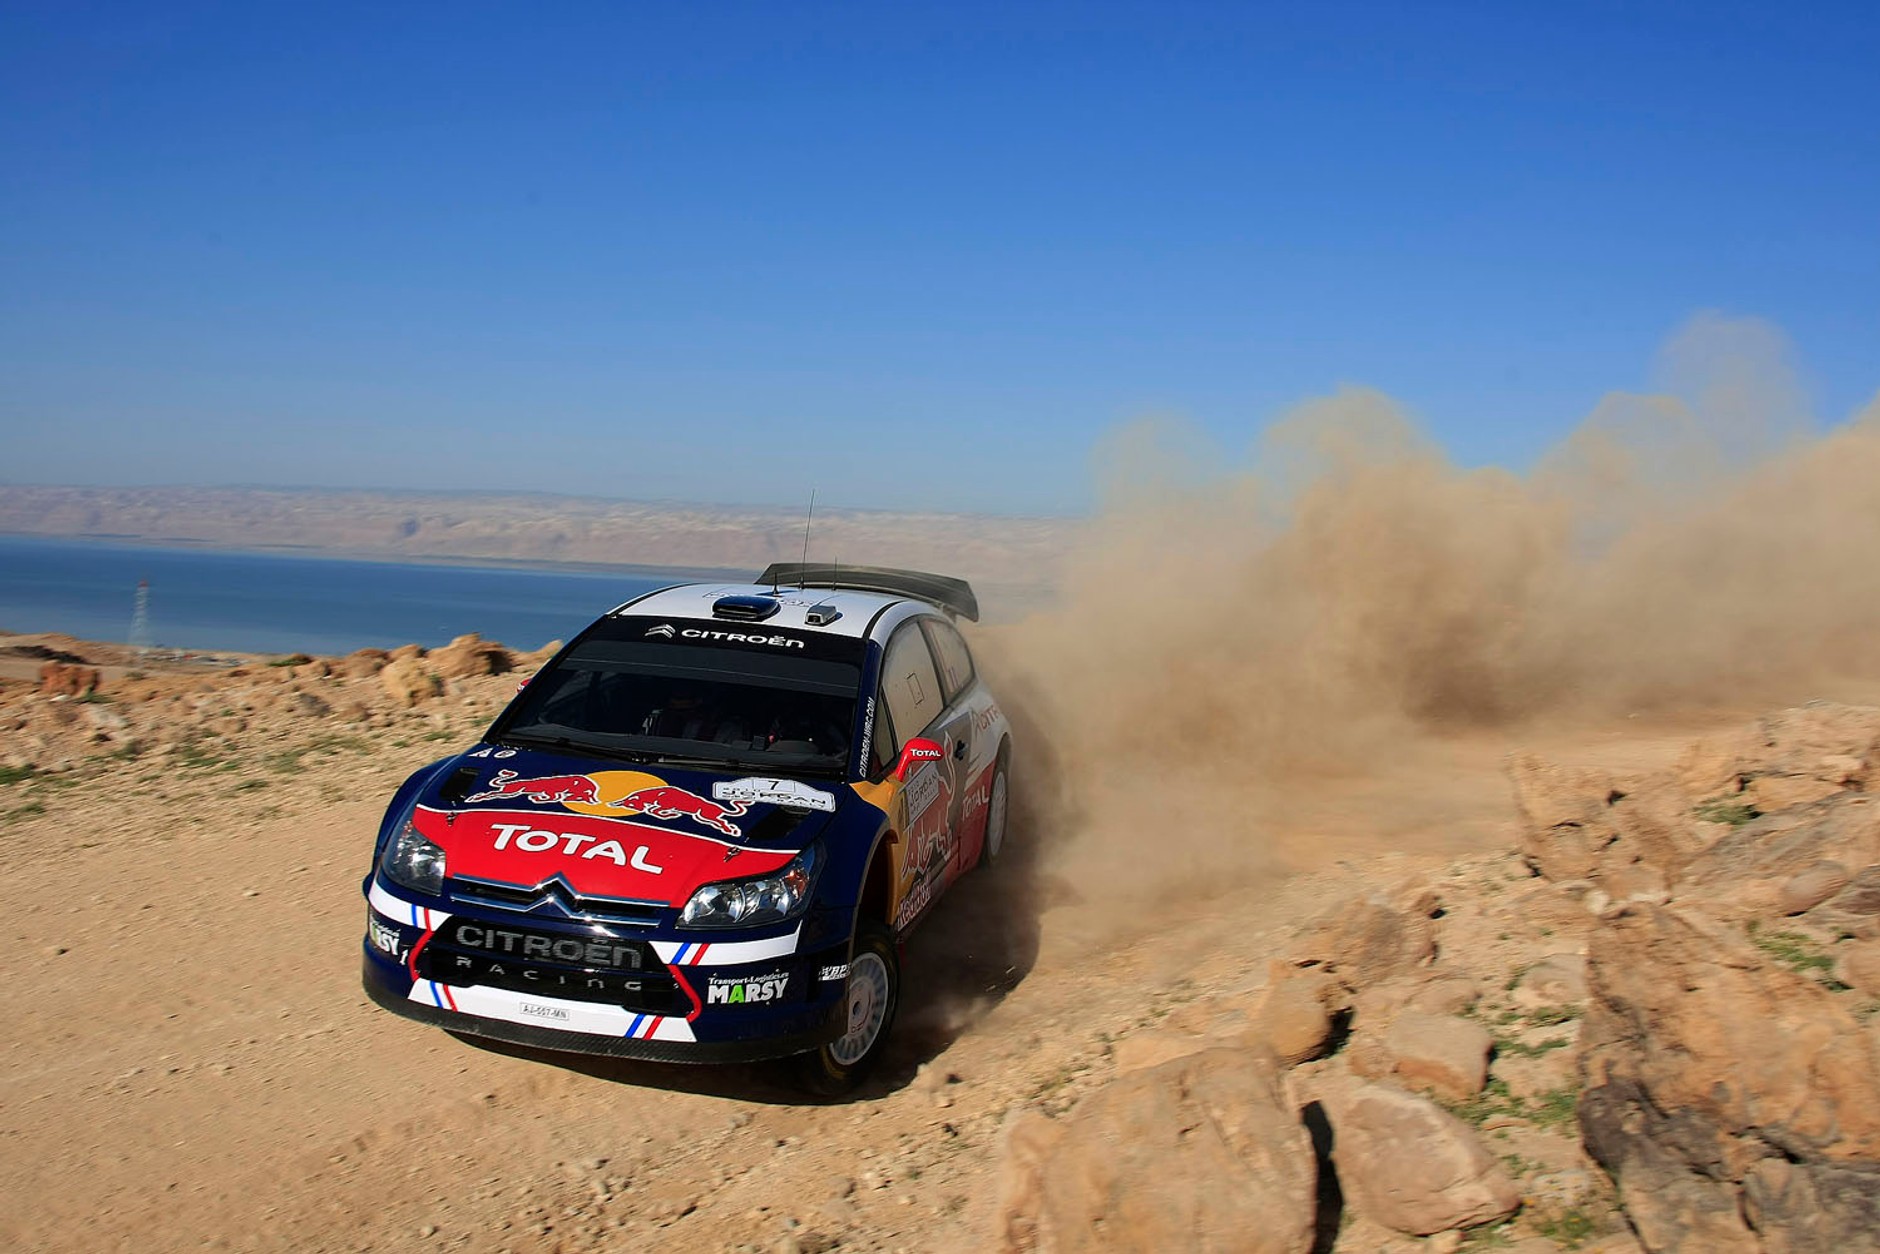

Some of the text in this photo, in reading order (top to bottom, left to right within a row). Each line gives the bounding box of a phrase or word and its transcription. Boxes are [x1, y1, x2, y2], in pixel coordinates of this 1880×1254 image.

[910, 748, 942, 757] TOTAL
[767, 780, 779, 791] 7
[962, 785, 990, 823] TOTAL
[490, 823, 663, 875] TOTAL
[706, 977, 789, 1004] MARSY
